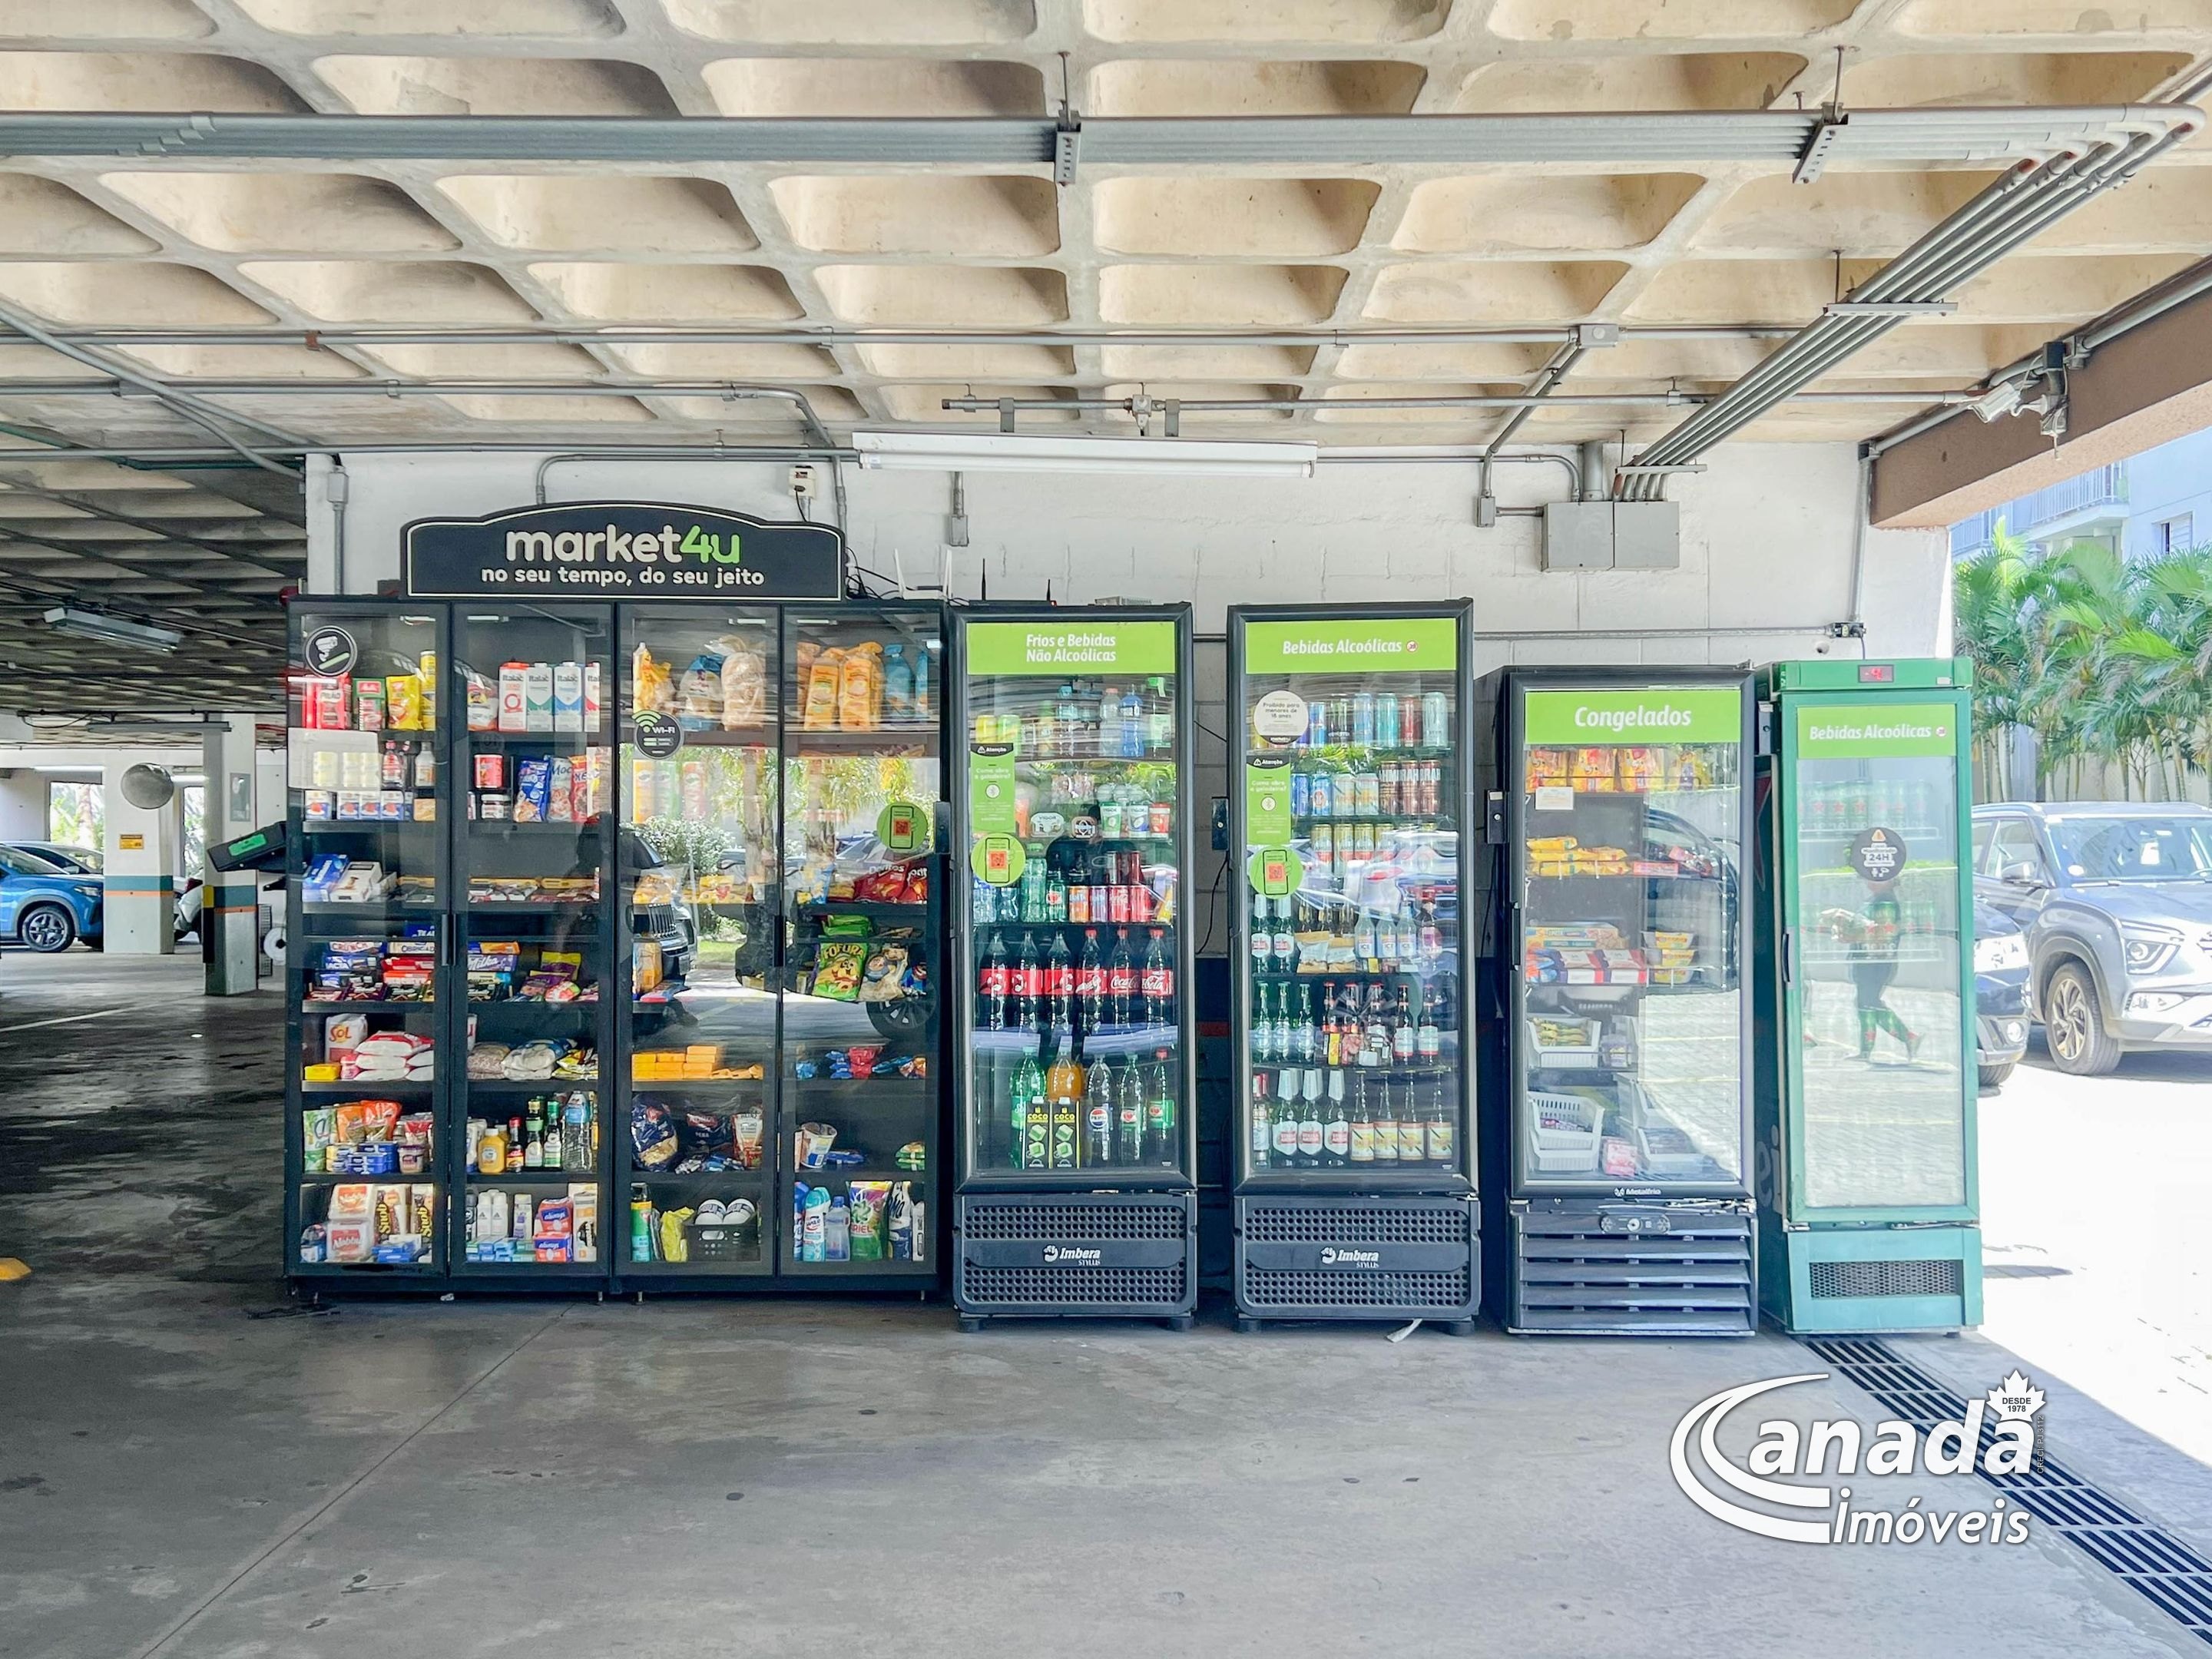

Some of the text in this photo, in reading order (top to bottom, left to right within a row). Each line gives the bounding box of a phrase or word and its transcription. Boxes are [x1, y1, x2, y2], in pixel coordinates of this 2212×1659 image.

[506, 524, 740, 564] market4u
[482, 566, 765, 588] no seu tempo, do seu jeito
[1026, 634, 1115, 647] Frios e Bebidas
[1283, 639, 1402, 654] Bebidas Alcoólicas
[1026, 648, 1116, 662] Não Alcoólicas
[1575, 704, 1691, 732] Congelados
[1810, 724, 1932, 740] Bebidas Alcoólicas
[824, 944, 864, 959] FOFURA
[1060, 1247, 1101, 1260] Imbera
[1337, 1250, 1379, 1262] Imbera
